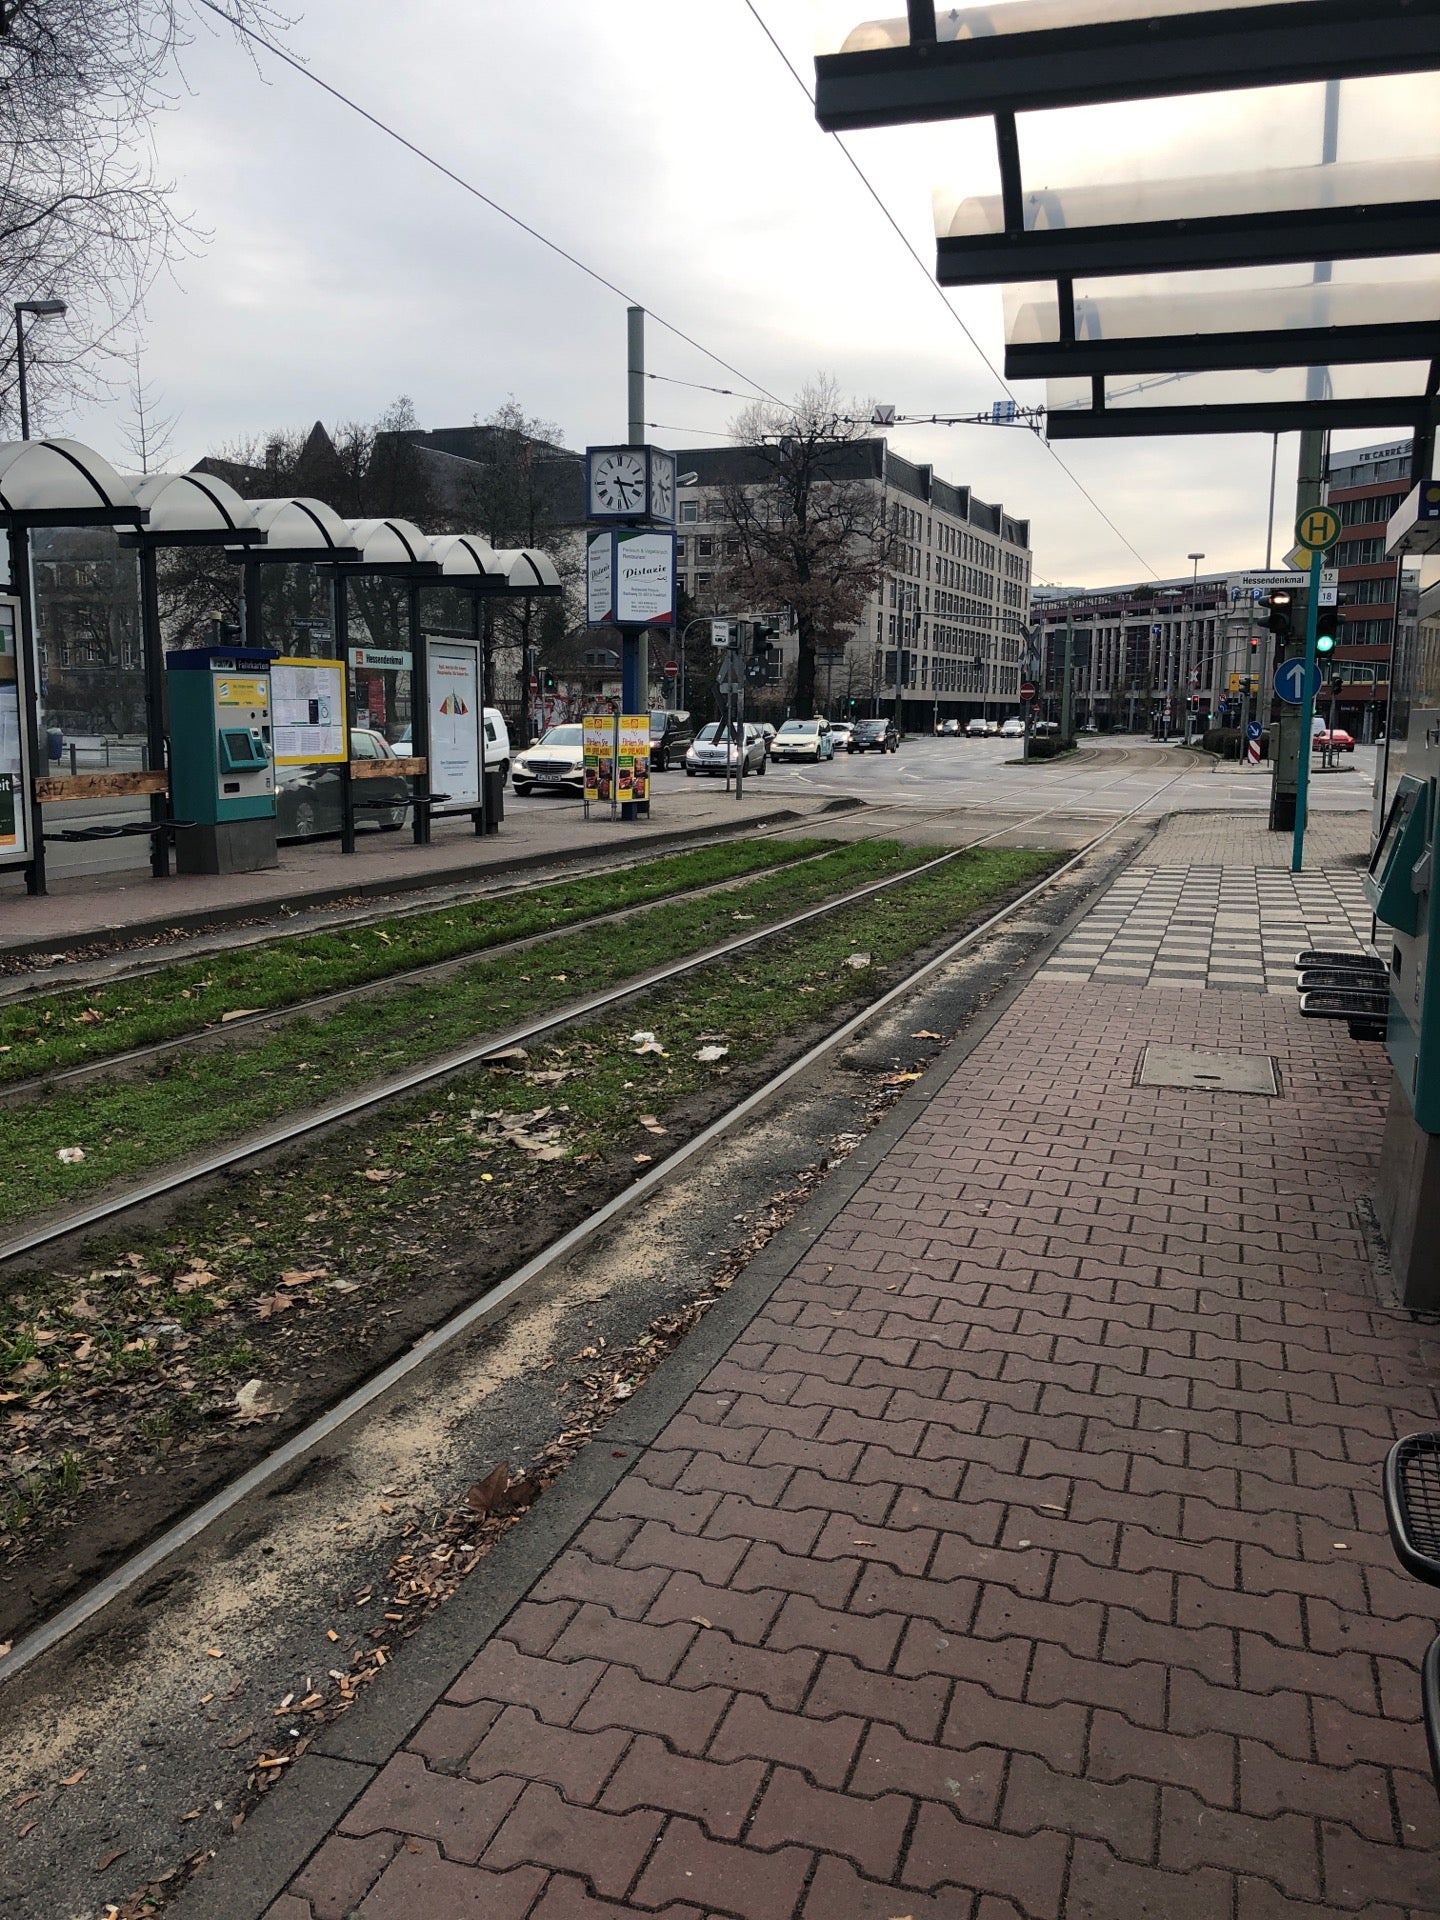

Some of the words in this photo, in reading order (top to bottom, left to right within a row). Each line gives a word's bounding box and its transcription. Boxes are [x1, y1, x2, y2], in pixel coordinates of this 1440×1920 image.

[1308, 516, 1328, 541] H
[622, 564, 667, 578] Pistazie
[1242, 575, 1304, 585] Hessendenkmal
[1323, 573, 1333, 581] 12
[1322, 592, 1332, 600] 18
[366, 653, 404, 665] Hessendenkmal
[238, 661, 270, 670] Fahrkarten
